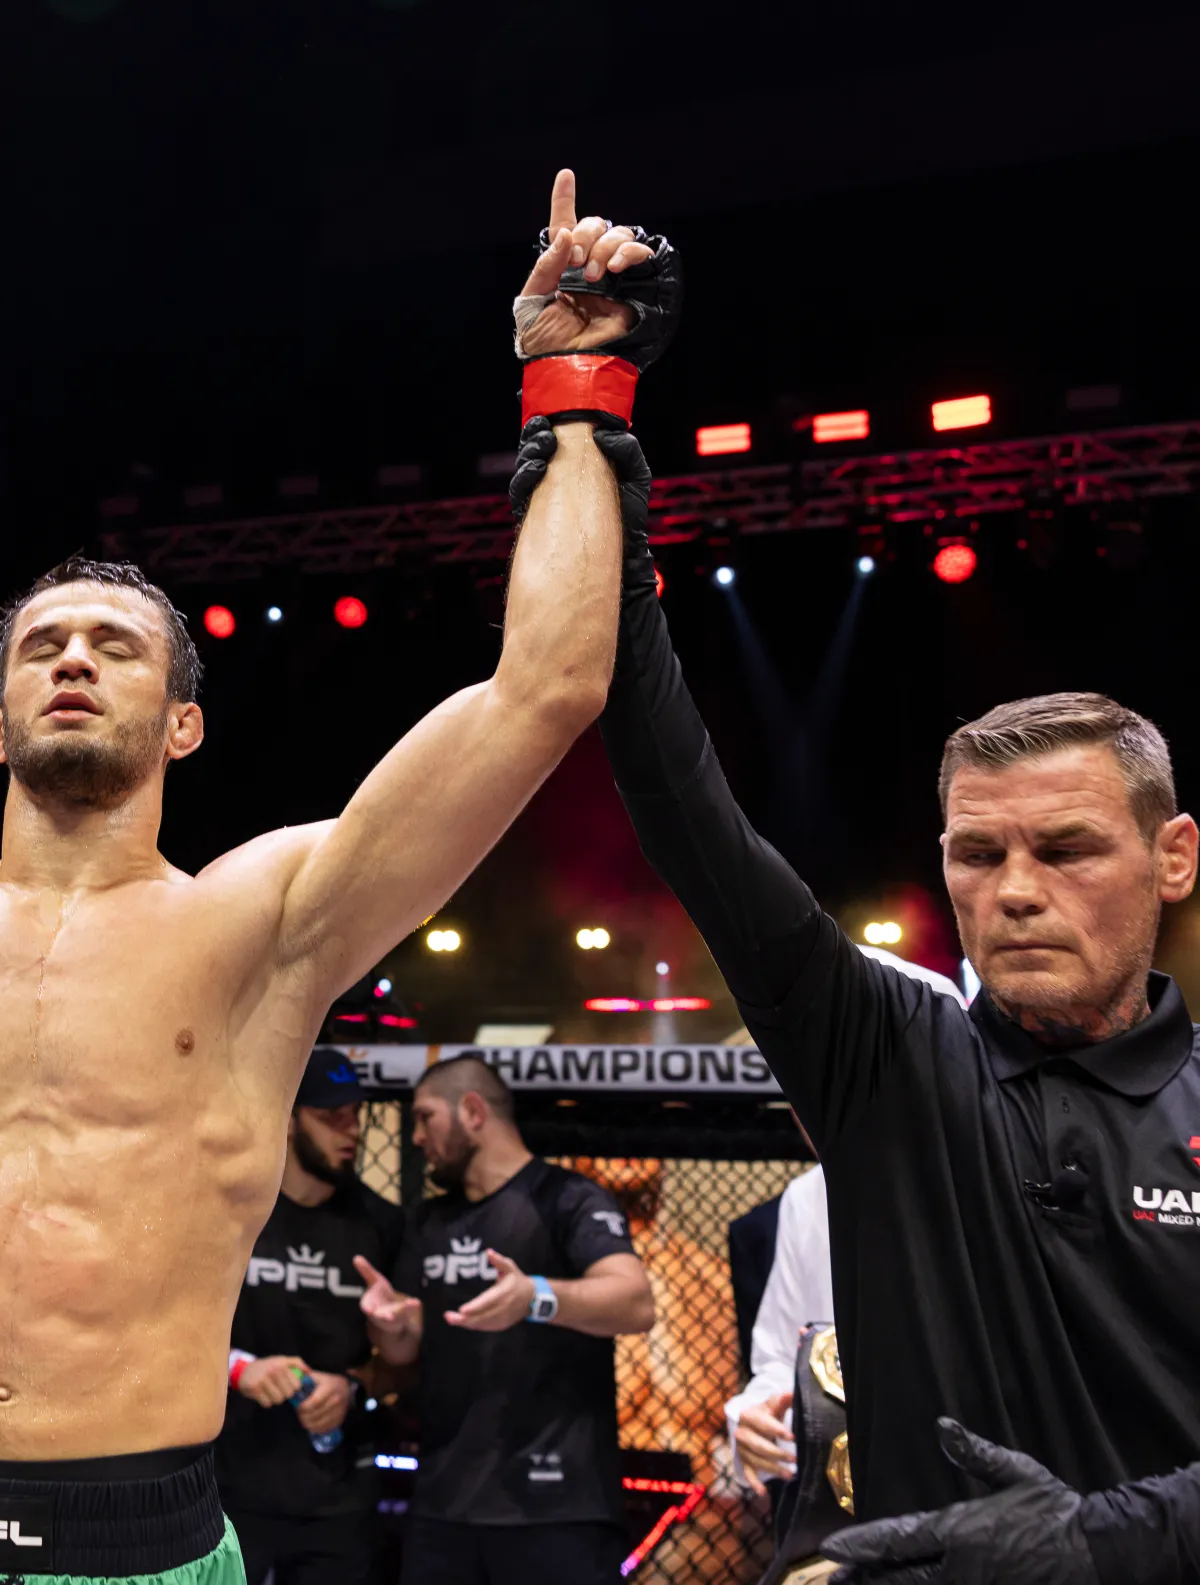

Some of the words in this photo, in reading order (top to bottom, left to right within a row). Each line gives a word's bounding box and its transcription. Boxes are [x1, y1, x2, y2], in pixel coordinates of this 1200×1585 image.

[1132, 1209, 1156, 1222] UAE
[1158, 1212, 1194, 1226] MIXED
[247, 1257, 363, 1298] PFL
